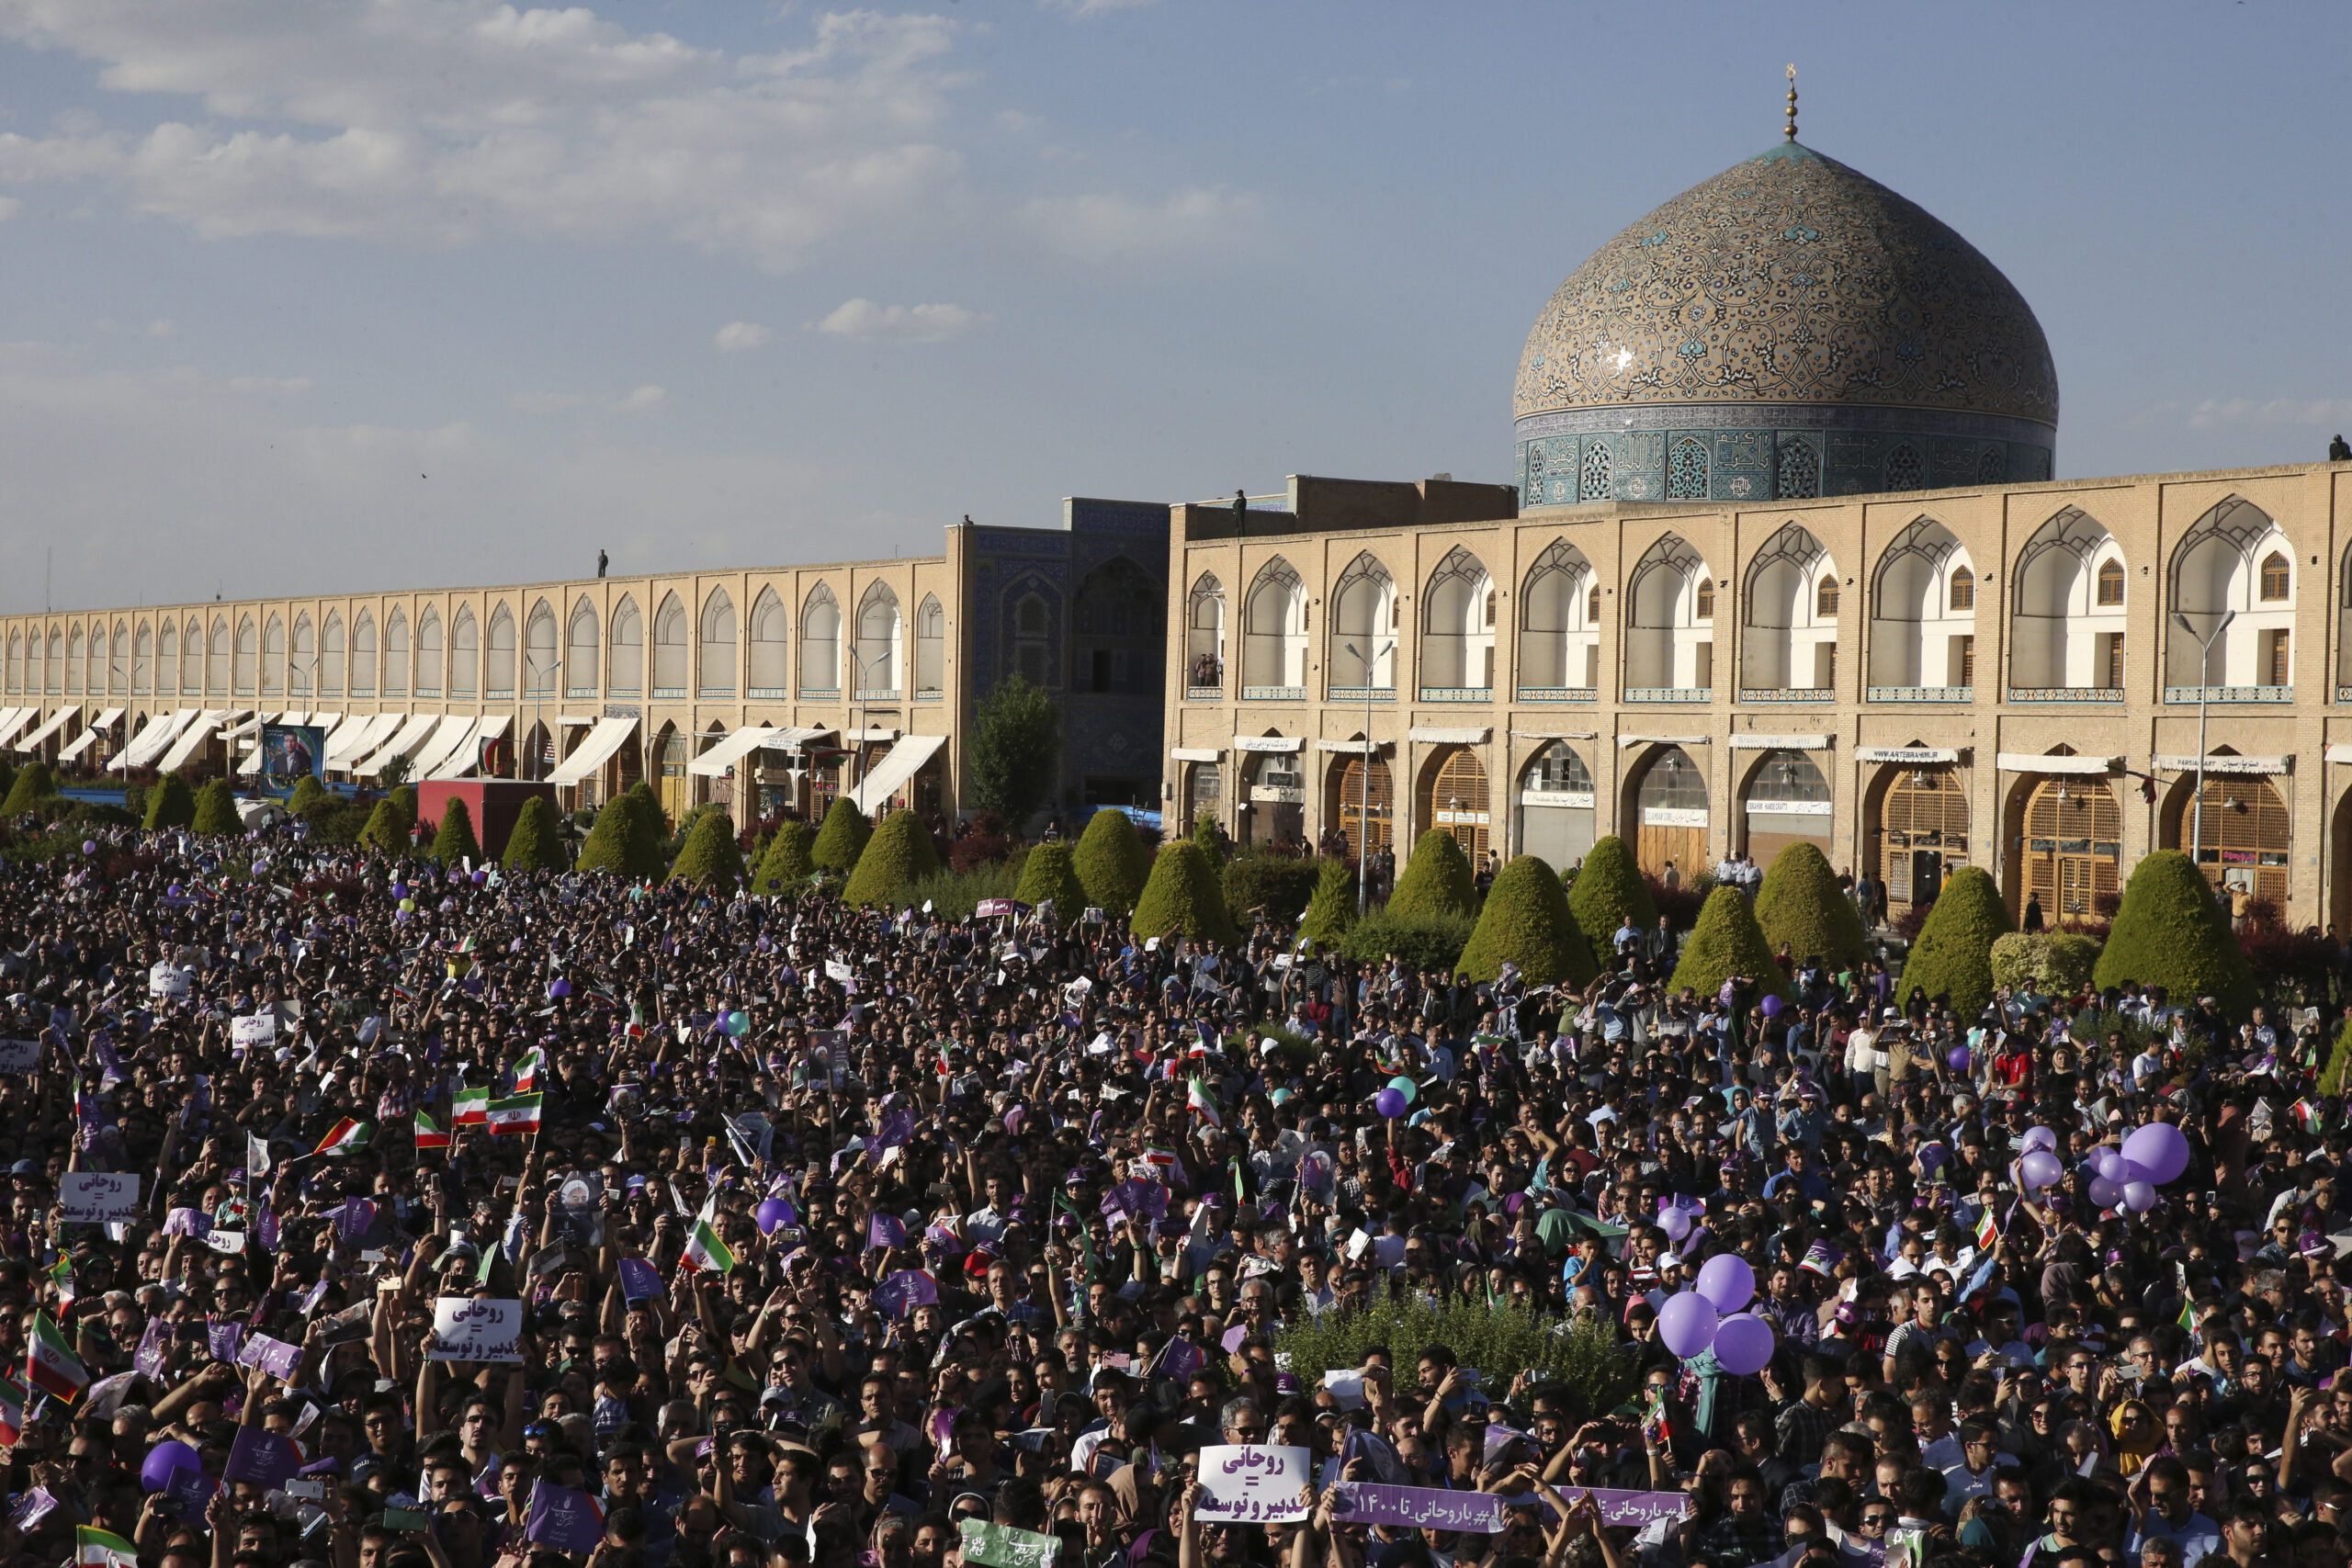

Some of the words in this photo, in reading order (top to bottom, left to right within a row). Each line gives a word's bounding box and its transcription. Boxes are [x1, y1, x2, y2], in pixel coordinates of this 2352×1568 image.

[240, 1017, 265, 1029] روحانی
[78, 1173, 122, 1193] روحانی
[452, 1299, 504, 1324] روحانی
[1222, 1445, 1285, 1475] روحانی
[1250, 1500, 1261, 1520] و
